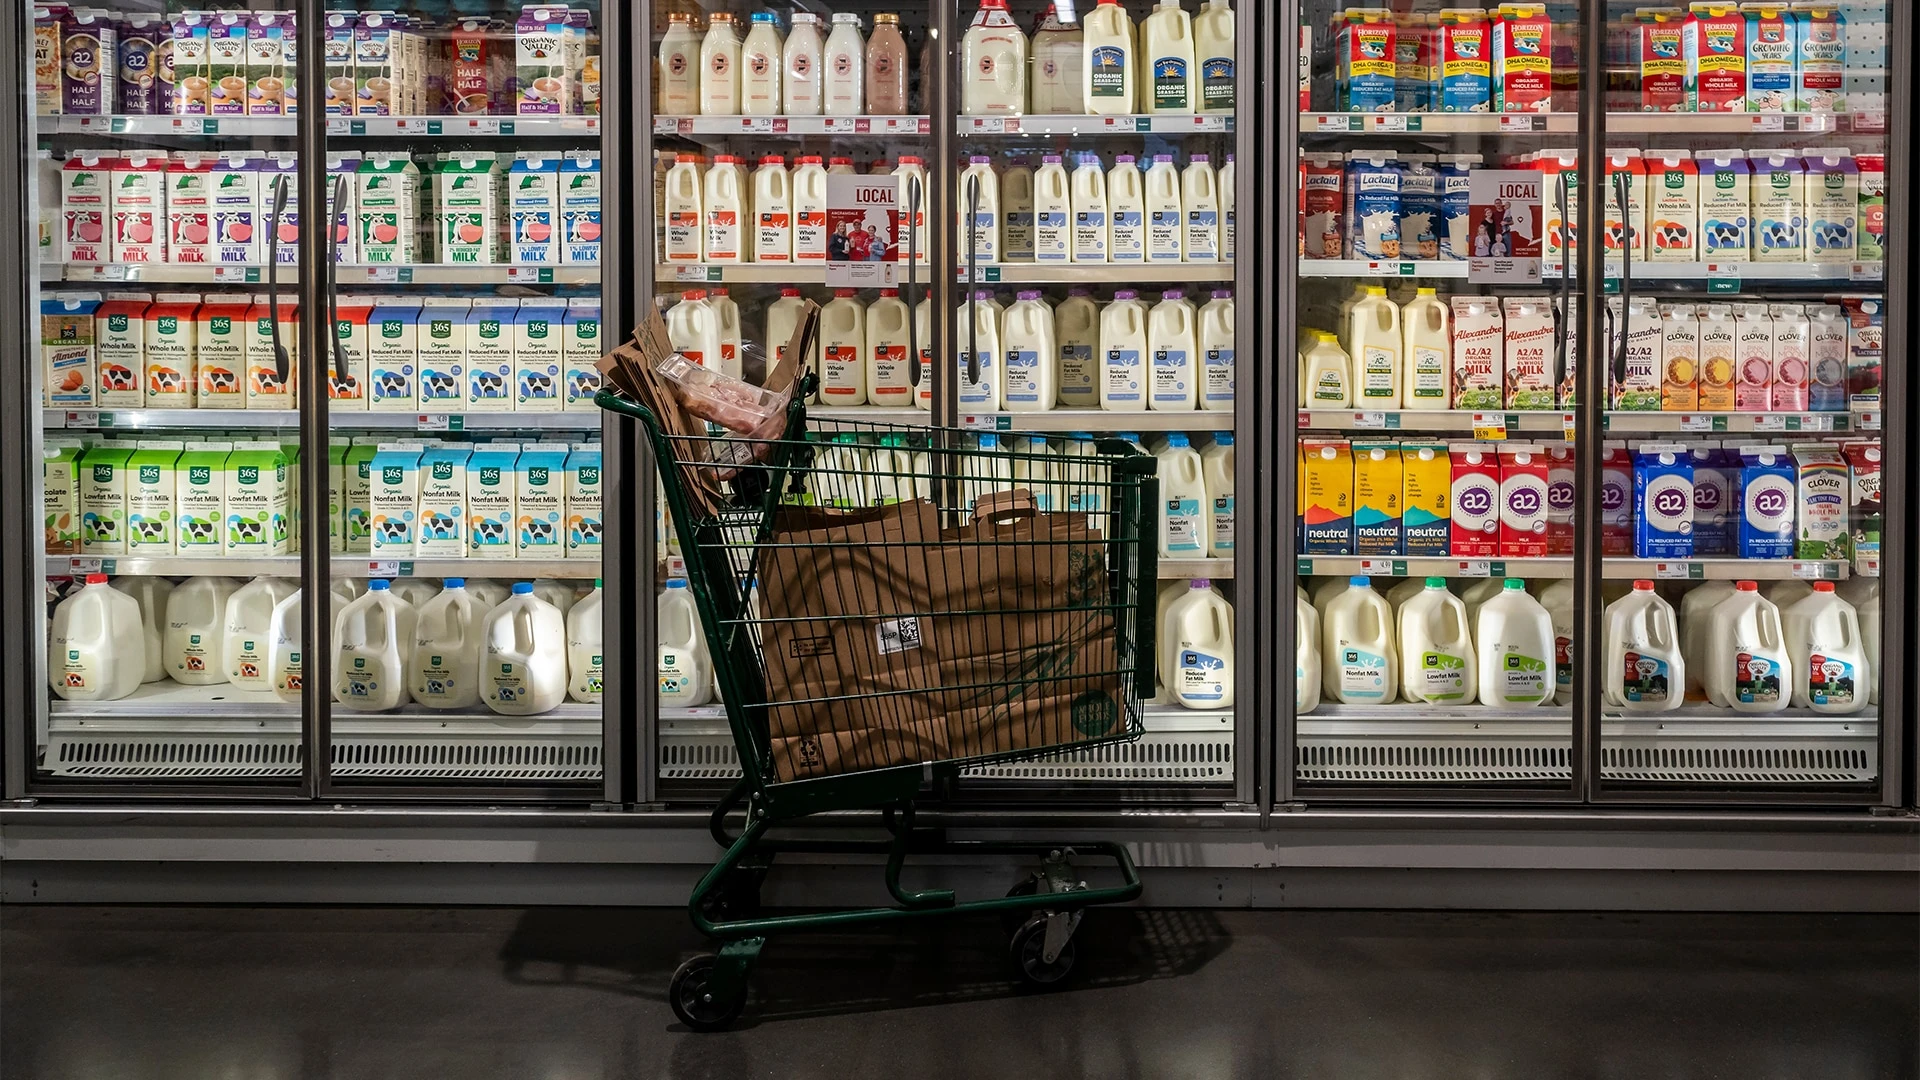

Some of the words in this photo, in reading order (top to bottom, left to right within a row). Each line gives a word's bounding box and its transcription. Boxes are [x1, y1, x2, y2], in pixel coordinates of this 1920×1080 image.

[1704, 23, 1737, 32] HORIZON
[520, 37, 557, 48] ORGANIC
[525, 43, 553, 52] VALLEY
[1752, 44, 1790, 53] GROWING
[1804, 44, 1842, 52] GROWING
[74, 54, 91, 64] a2
[1522, 57, 1549, 66] OMEGA-3
[1368, 61, 1393, 69] OMEGA-3
[1460, 61, 1487, 69] OMEGA-3
[1362, 175, 1397, 186] Lactaid
[1666, 173, 1682, 183] 365
[1717, 173, 1734, 183] 365
[1772, 173, 1789, 183] 365
[856, 188, 894, 203] LOCAL
[1499, 184, 1537, 199] LOCAL
[72, 252, 97, 261] MILK
[123, 252, 149, 262] MILK
[178, 253, 204, 262] MILK
[222, 252, 246, 262] MILK
[368, 253, 392, 261] MILK
[452, 252, 477, 262] MILK
[521, 252, 546, 261] MILK
[572, 251, 597, 260] MILK
[110, 316, 126, 326] 365
[158, 318, 175, 328] 365
[211, 318, 228, 329] 365
[384, 322, 400, 332] 365
[433, 322, 449, 332] 365
[481, 322, 497, 332] 365
[529, 322, 546, 332] 365
[578, 322, 594, 332] 365
[1455, 326, 1502, 340] Alexandre
[51, 350, 88, 362] Almond
[1465, 348, 1491, 356] A2/A2
[1517, 348, 1543, 356] A2/A2
[1465, 365, 1492, 374] MILK
[1517, 366, 1544, 374] MILK
[95, 466, 111, 476] 365
[141, 467, 158, 477] 365
[191, 468, 208, 478] 365
[240, 468, 256, 478] 365
[385, 468, 402, 478] 365
[434, 464, 451, 473] 365
[482, 470, 498, 479] 365
[530, 470, 547, 479] 365
[1808, 478, 1840, 489] CLOVER
[1463, 492, 1488, 510] a2
[1659, 494, 1683, 510] a2
[1309, 528, 1348, 538] neutral
[1359, 526, 1398, 537] neutral
[1407, 527, 1446, 537] neutral
[1748, 660, 1770, 670] ORGANIC
